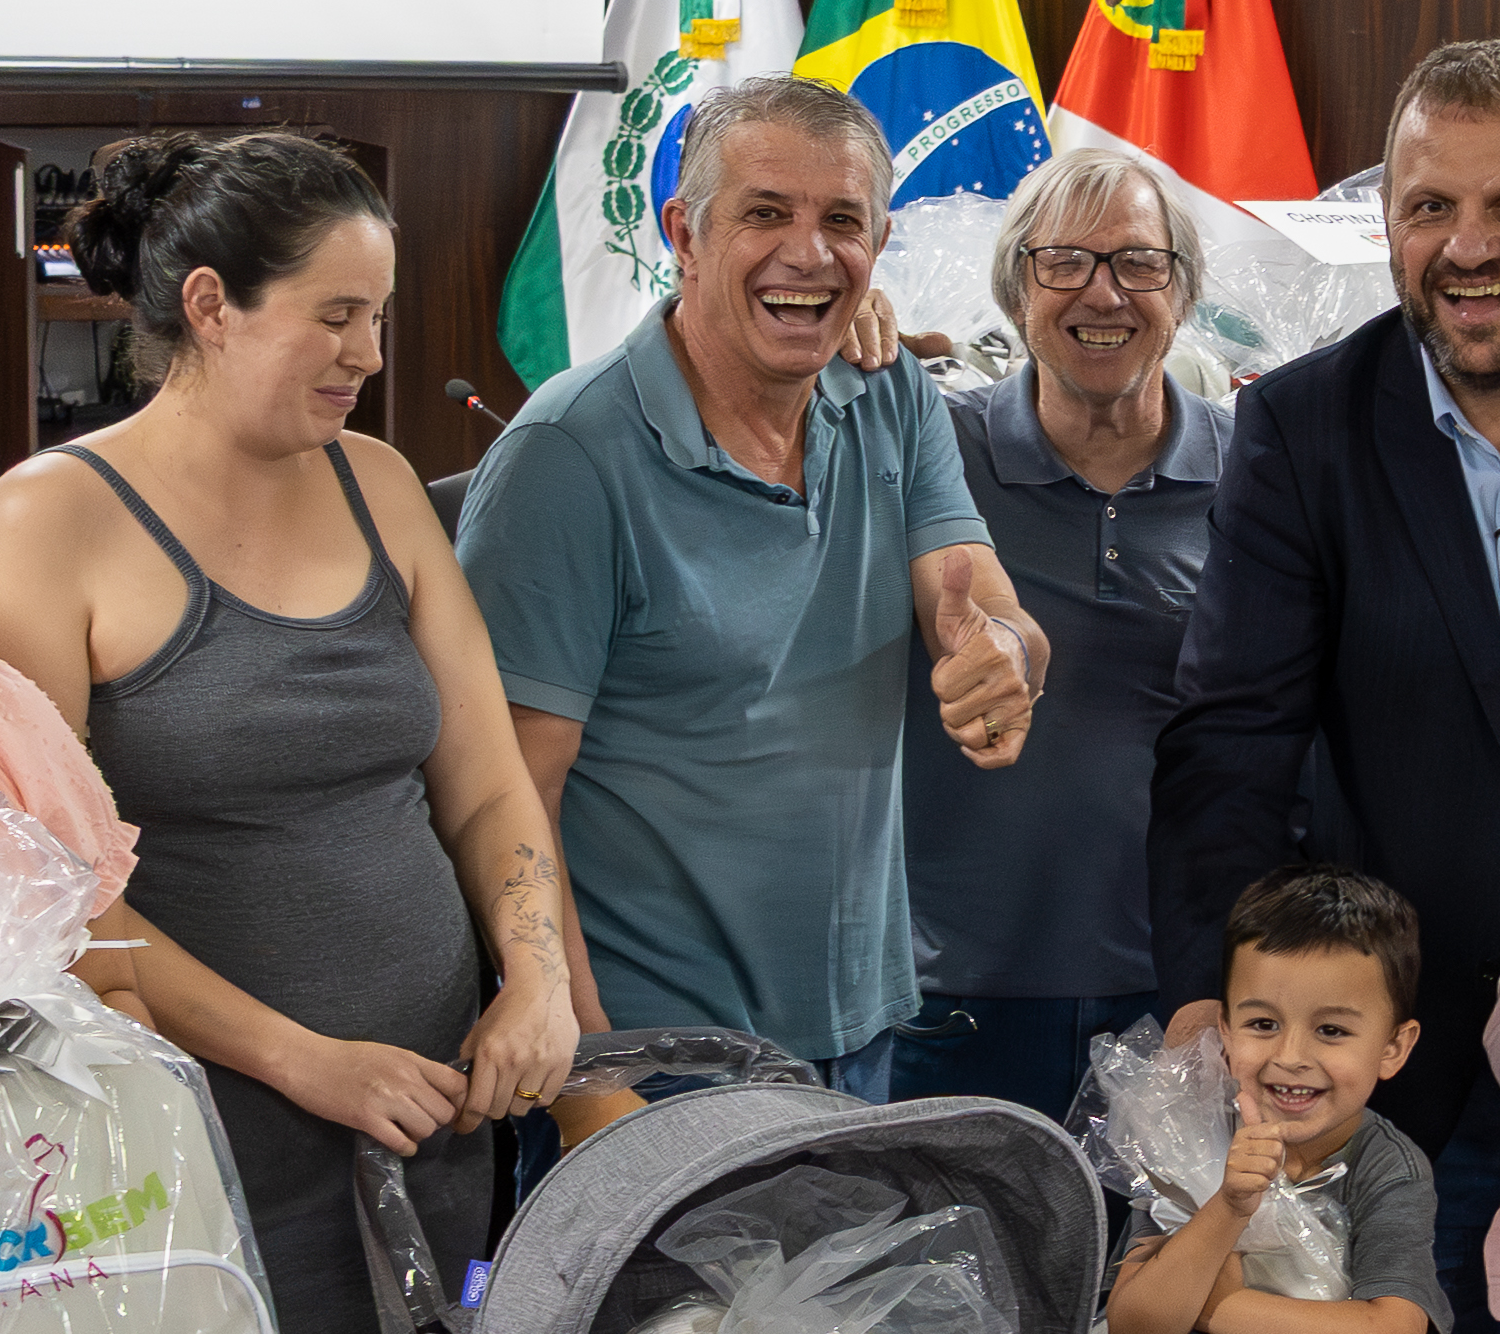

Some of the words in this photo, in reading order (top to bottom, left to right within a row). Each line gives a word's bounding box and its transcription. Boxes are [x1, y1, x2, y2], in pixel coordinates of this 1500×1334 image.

[894, 166, 906, 180] E
[907, 83, 1021, 161] PROGRESSO
[60, 1171, 171, 1252] BEM
